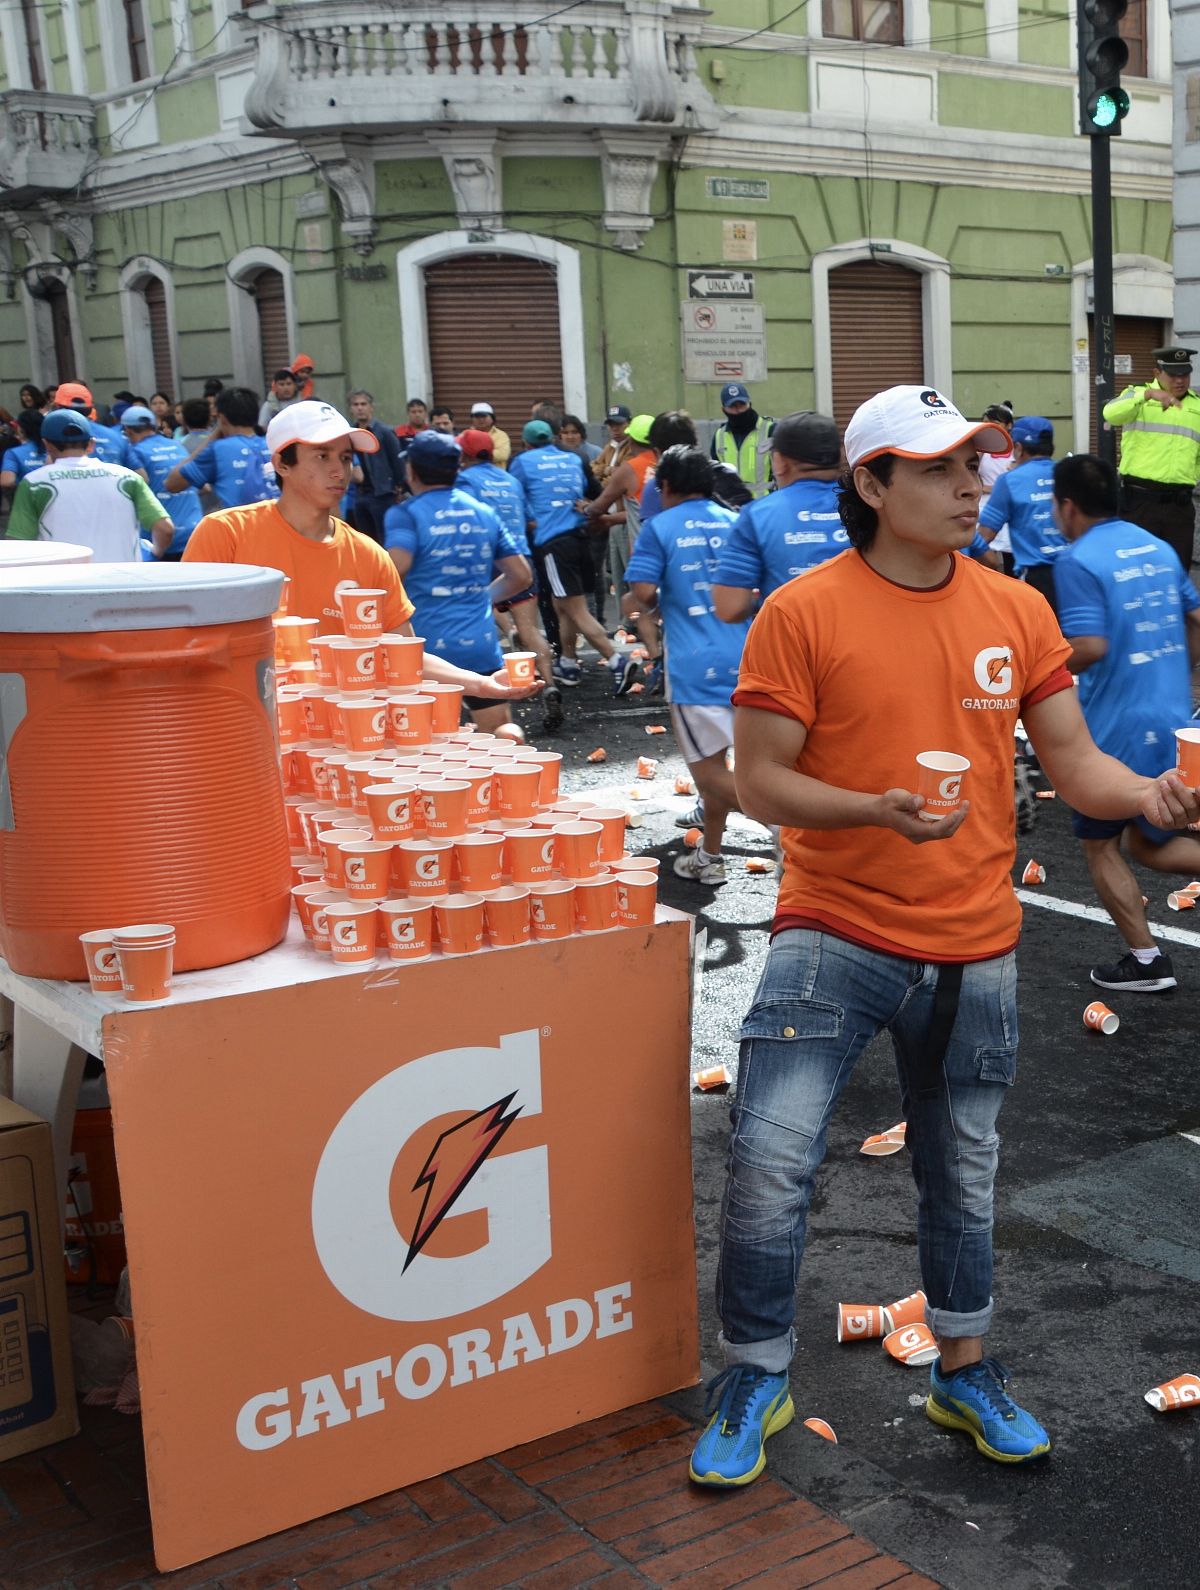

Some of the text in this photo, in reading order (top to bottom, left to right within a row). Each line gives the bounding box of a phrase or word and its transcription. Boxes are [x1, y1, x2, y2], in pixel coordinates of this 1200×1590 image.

[707, 281, 746, 291] UNA VIA
[920, 390, 946, 408] G
[356, 600, 377, 623] G
[356, 652, 375, 675] G
[515, 660, 530, 676] G
[973, 646, 1012, 695] G
[939, 774, 963, 799] G
[387, 798, 410, 824] G
[345, 857, 366, 882] G
[415, 854, 440, 880] G
[334, 920, 358, 946] G
[391, 917, 416, 942] G
[94, 947, 121, 974] G
[311, 1028, 552, 1322] G
[64, 1218, 123, 1237] RADE
[847, 1316, 867, 1335] G
[900, 1328, 920, 1348] G
[235, 1281, 633, 1451] GATORADE
